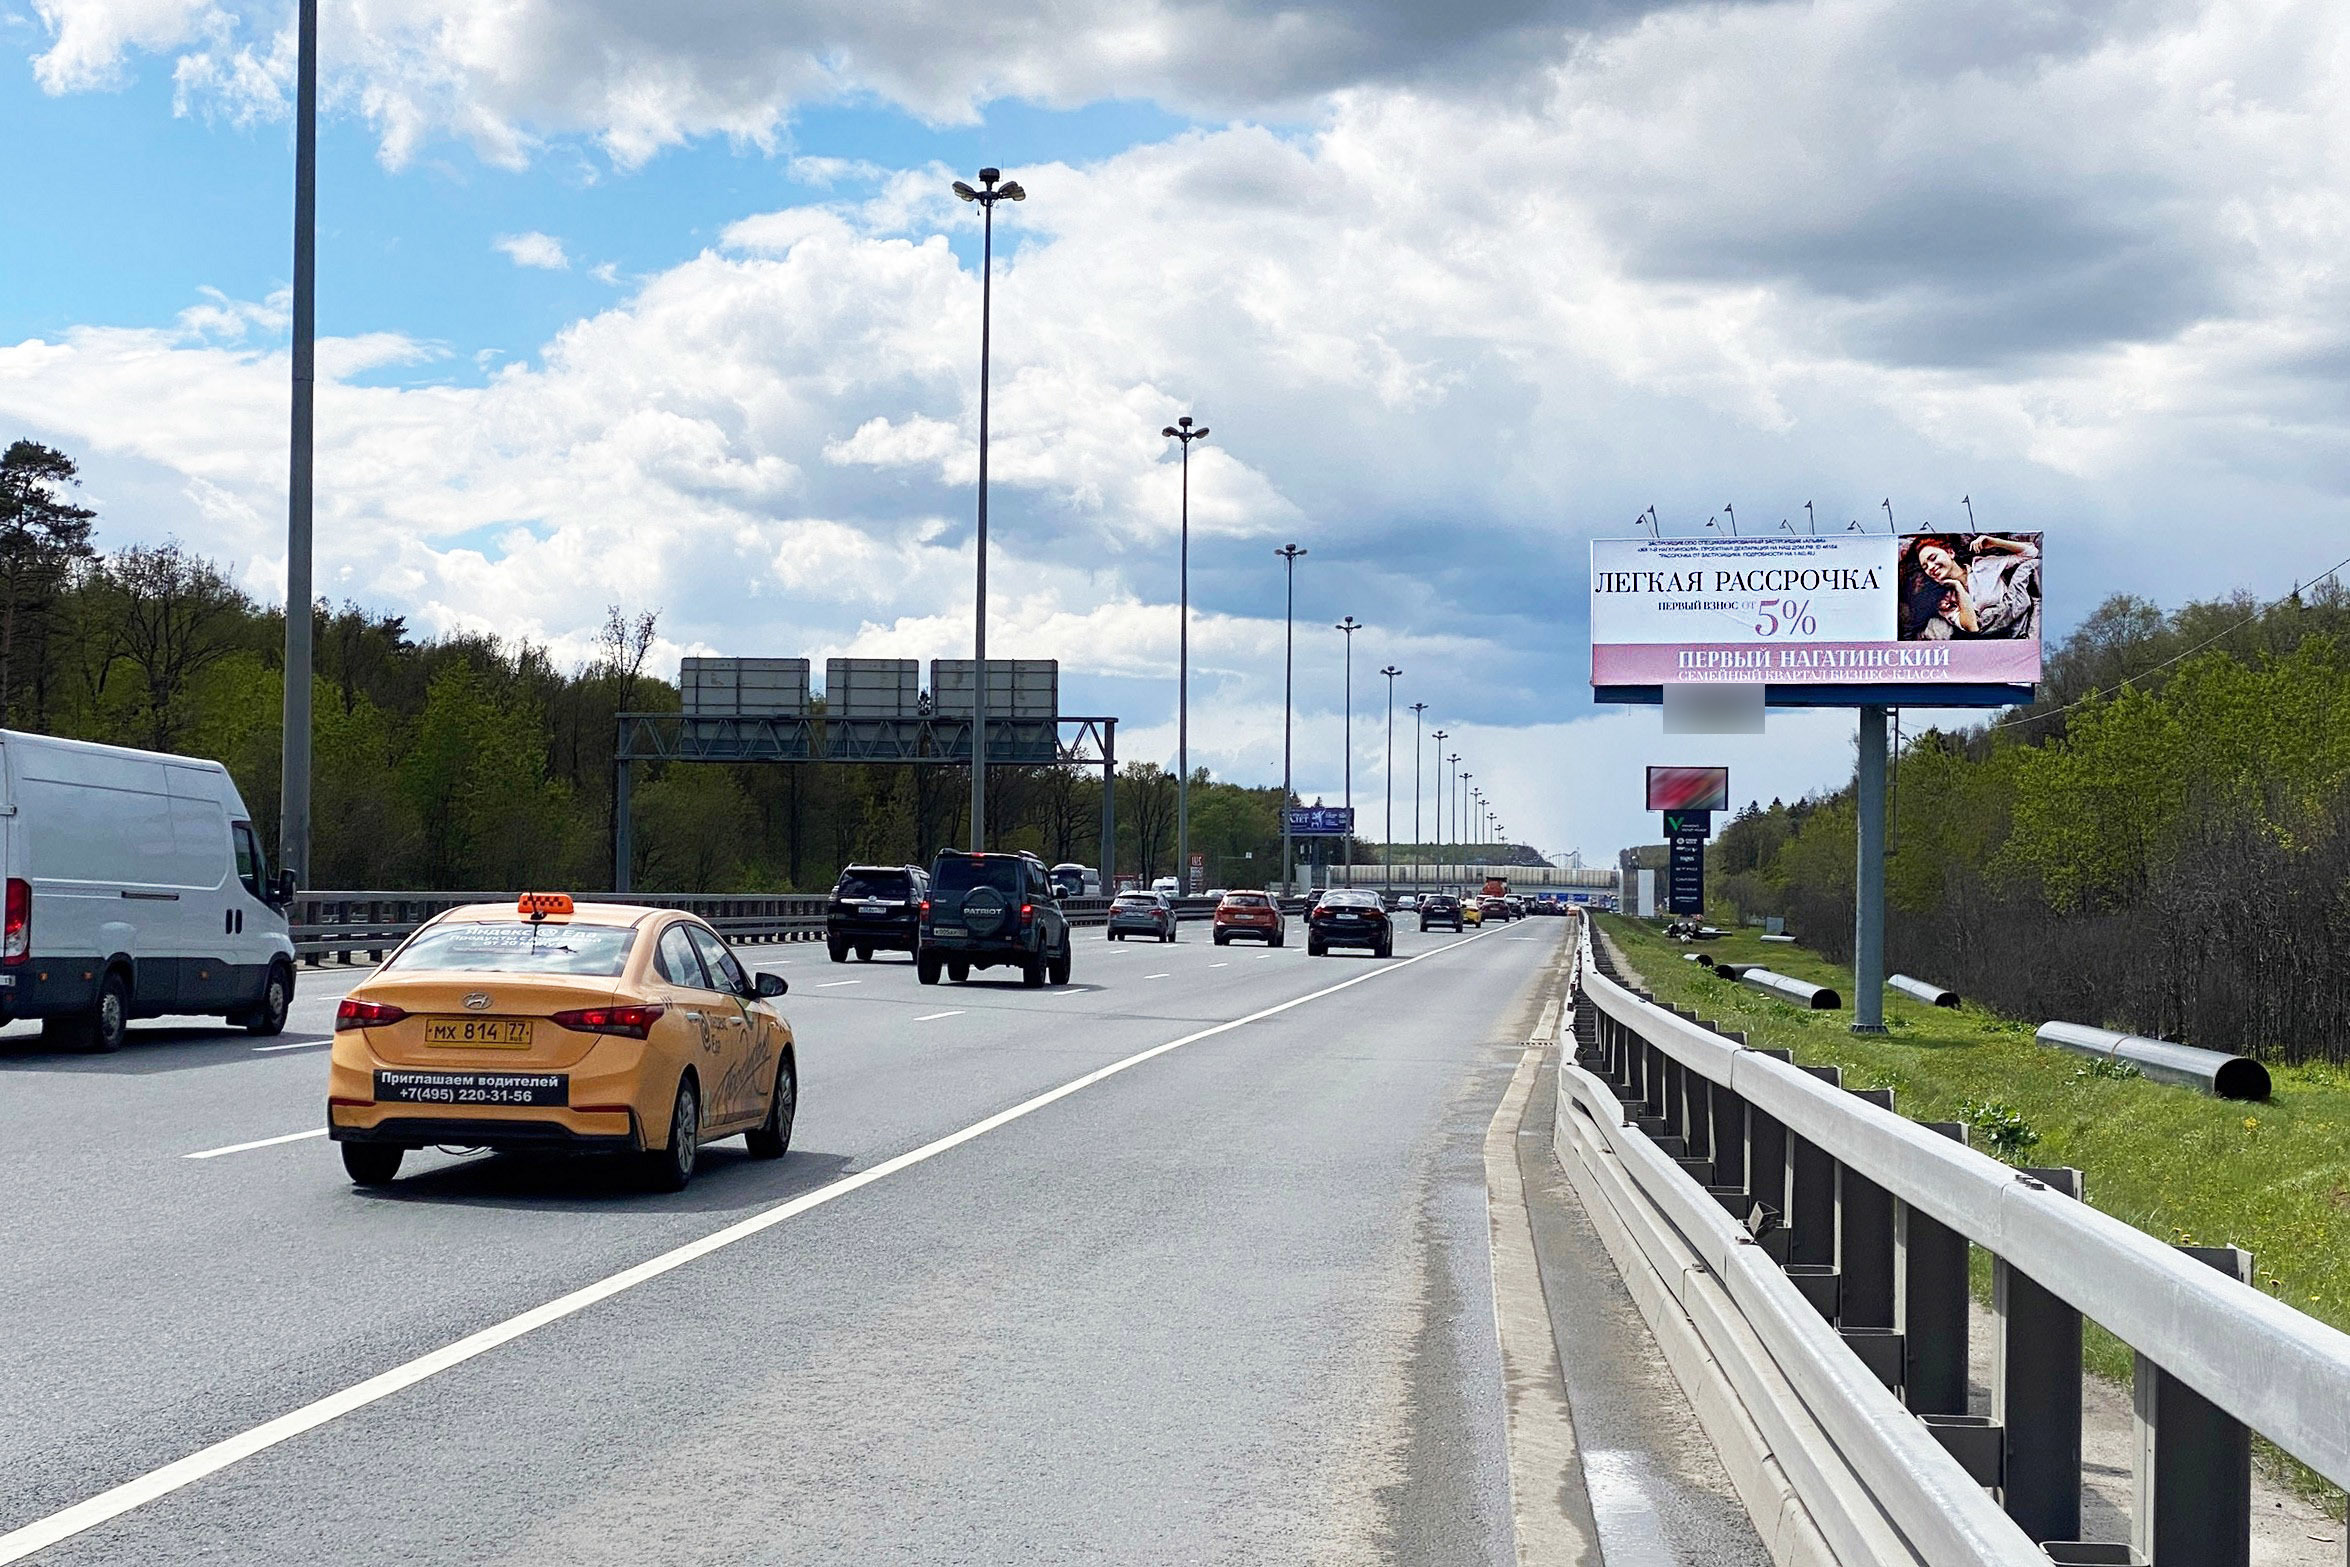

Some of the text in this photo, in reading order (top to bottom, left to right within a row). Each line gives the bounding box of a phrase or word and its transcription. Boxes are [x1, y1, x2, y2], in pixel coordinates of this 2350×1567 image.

[1595, 571, 1703, 593] ЛЕГКАЯ
[1658, 600, 1701, 611] ПЕРВЫЙ
[1704, 601, 1738, 611] ВЗНОС
[1755, 598, 1816, 636] 5%
[1678, 646, 1950, 668] ПЕРВЫЙ НАГАТИНСКИЙ
[1678, 669, 1762, 682] СЕМЕЙНЫЙ
[1765, 669, 1826, 681] КВАРТАЛ
[465, 927, 598, 938] Яндекс Еда
[464, 1023, 498, 1040] 814
[508, 1023, 526, 1036] 77
[381, 1072, 559, 1088] Приглашаем водителей
[400, 1087, 533, 1103] +7(495) 220-31-56
